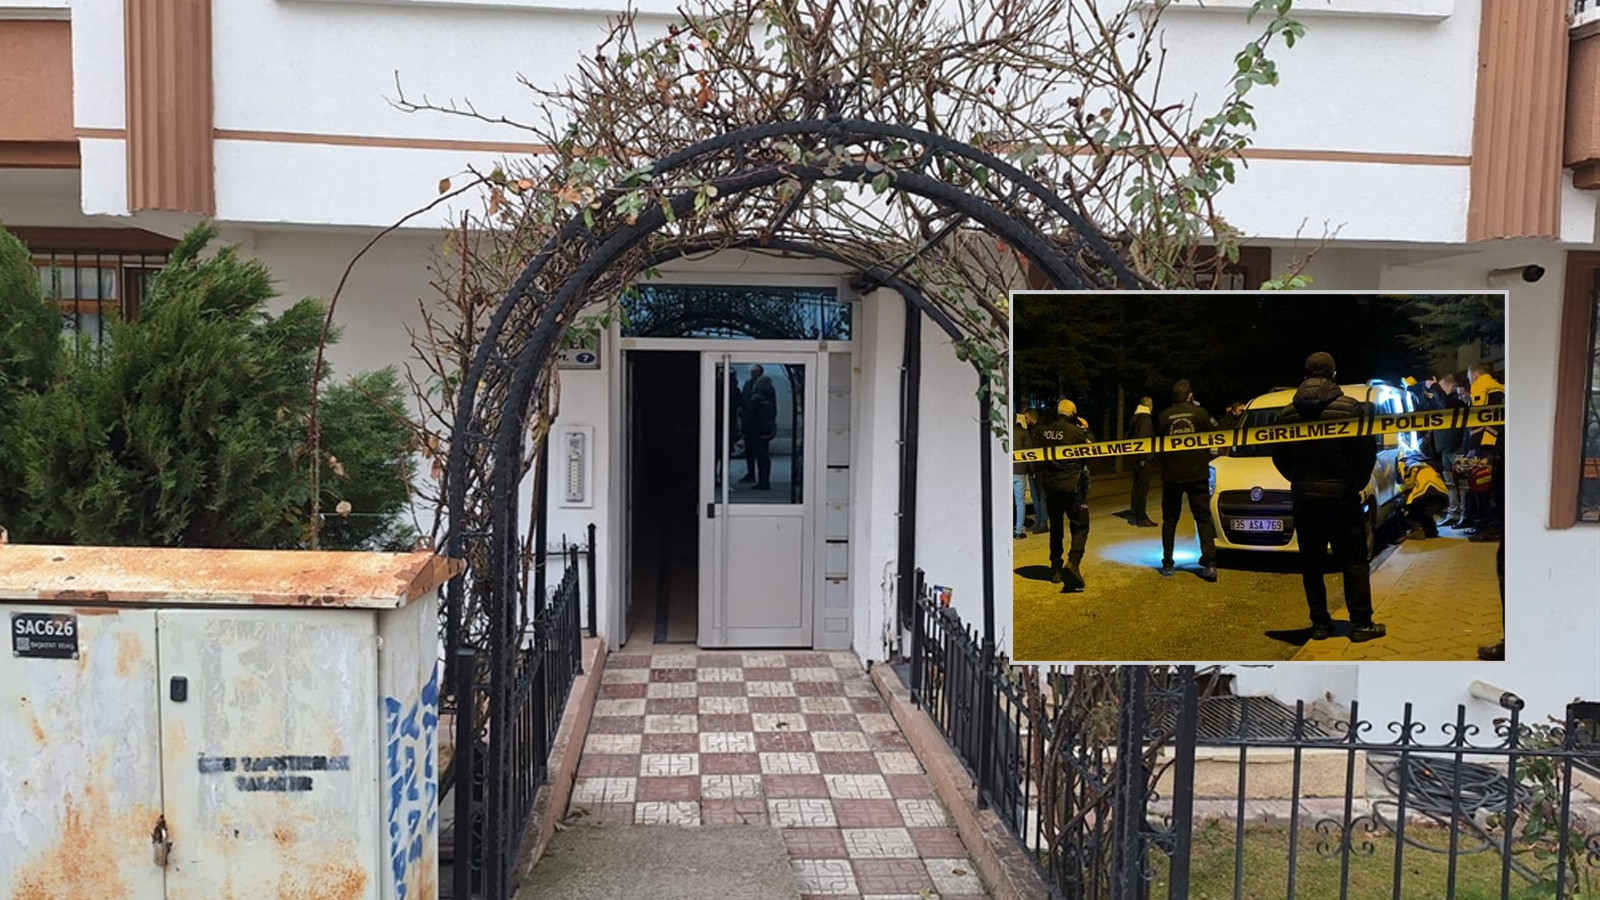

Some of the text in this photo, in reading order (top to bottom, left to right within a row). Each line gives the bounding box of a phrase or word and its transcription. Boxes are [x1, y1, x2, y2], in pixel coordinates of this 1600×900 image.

[581, 354, 590, 362] 7
[1235, 520, 1282, 530] 35 ASA 769
[15, 619, 74, 636] SAC626
